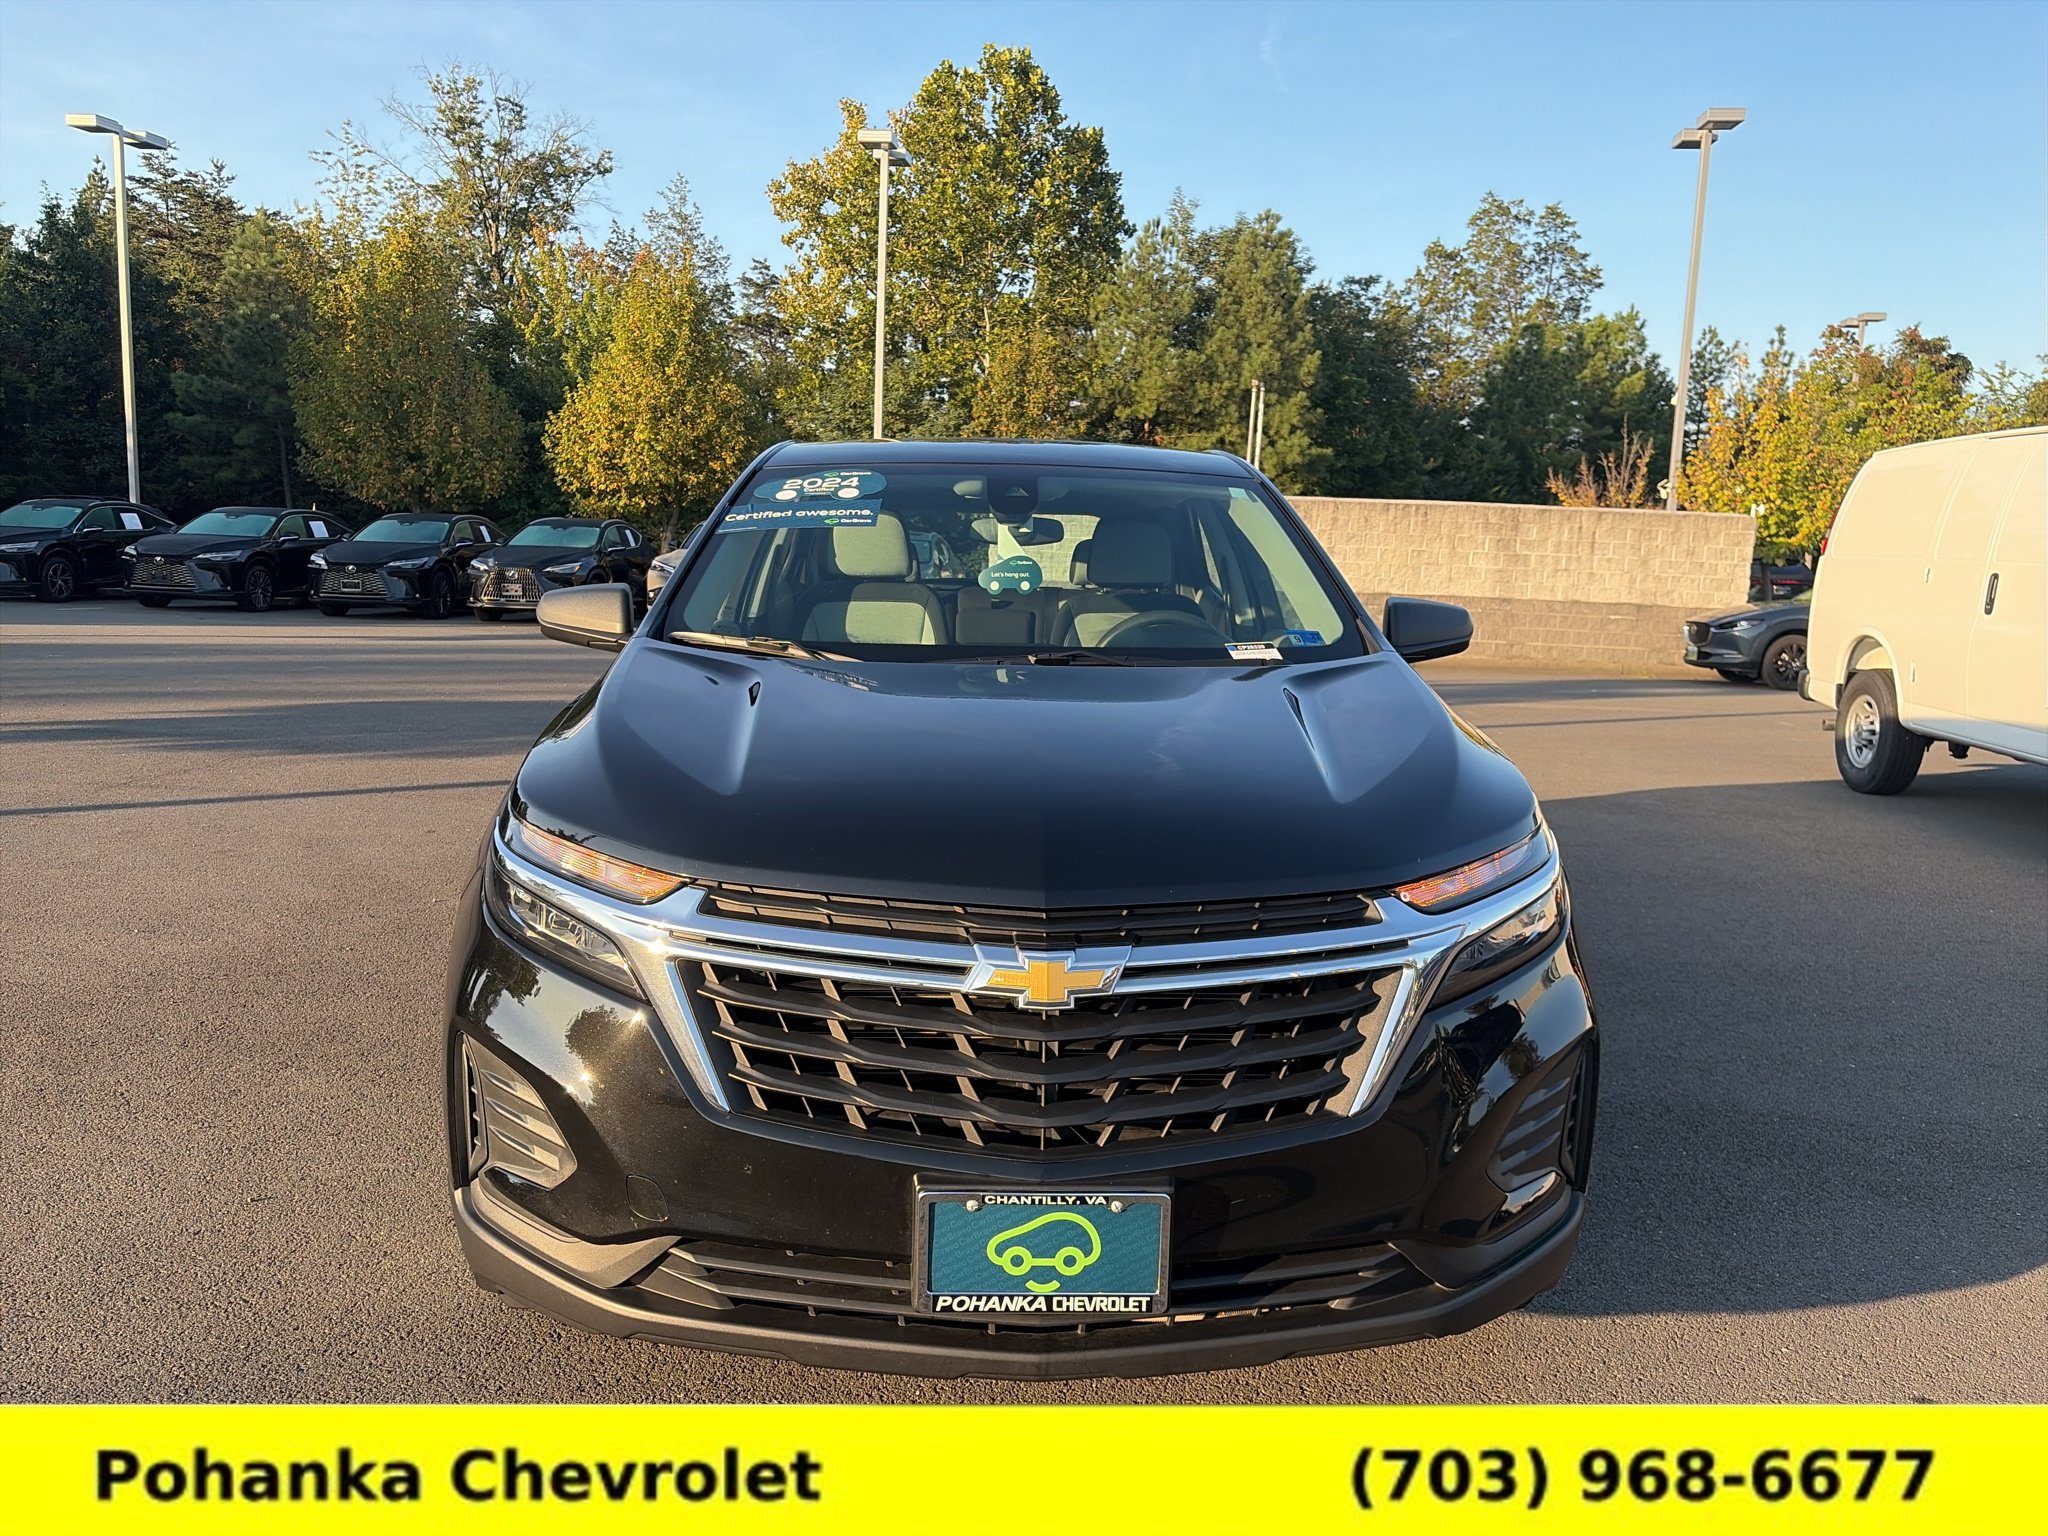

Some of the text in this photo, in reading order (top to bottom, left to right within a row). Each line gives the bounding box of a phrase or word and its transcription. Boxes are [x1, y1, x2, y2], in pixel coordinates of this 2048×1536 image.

[783, 477, 860, 490] 2024
[725, 508, 874, 522] Certified awesome.
[1005, 571, 1019, 580] hang
[1294, 635, 1303, 644] 9
[984, 1195, 1107, 1206] CHANTILLY, VA
[935, 1295, 1151, 1312] POHANKA CHEVROLET
